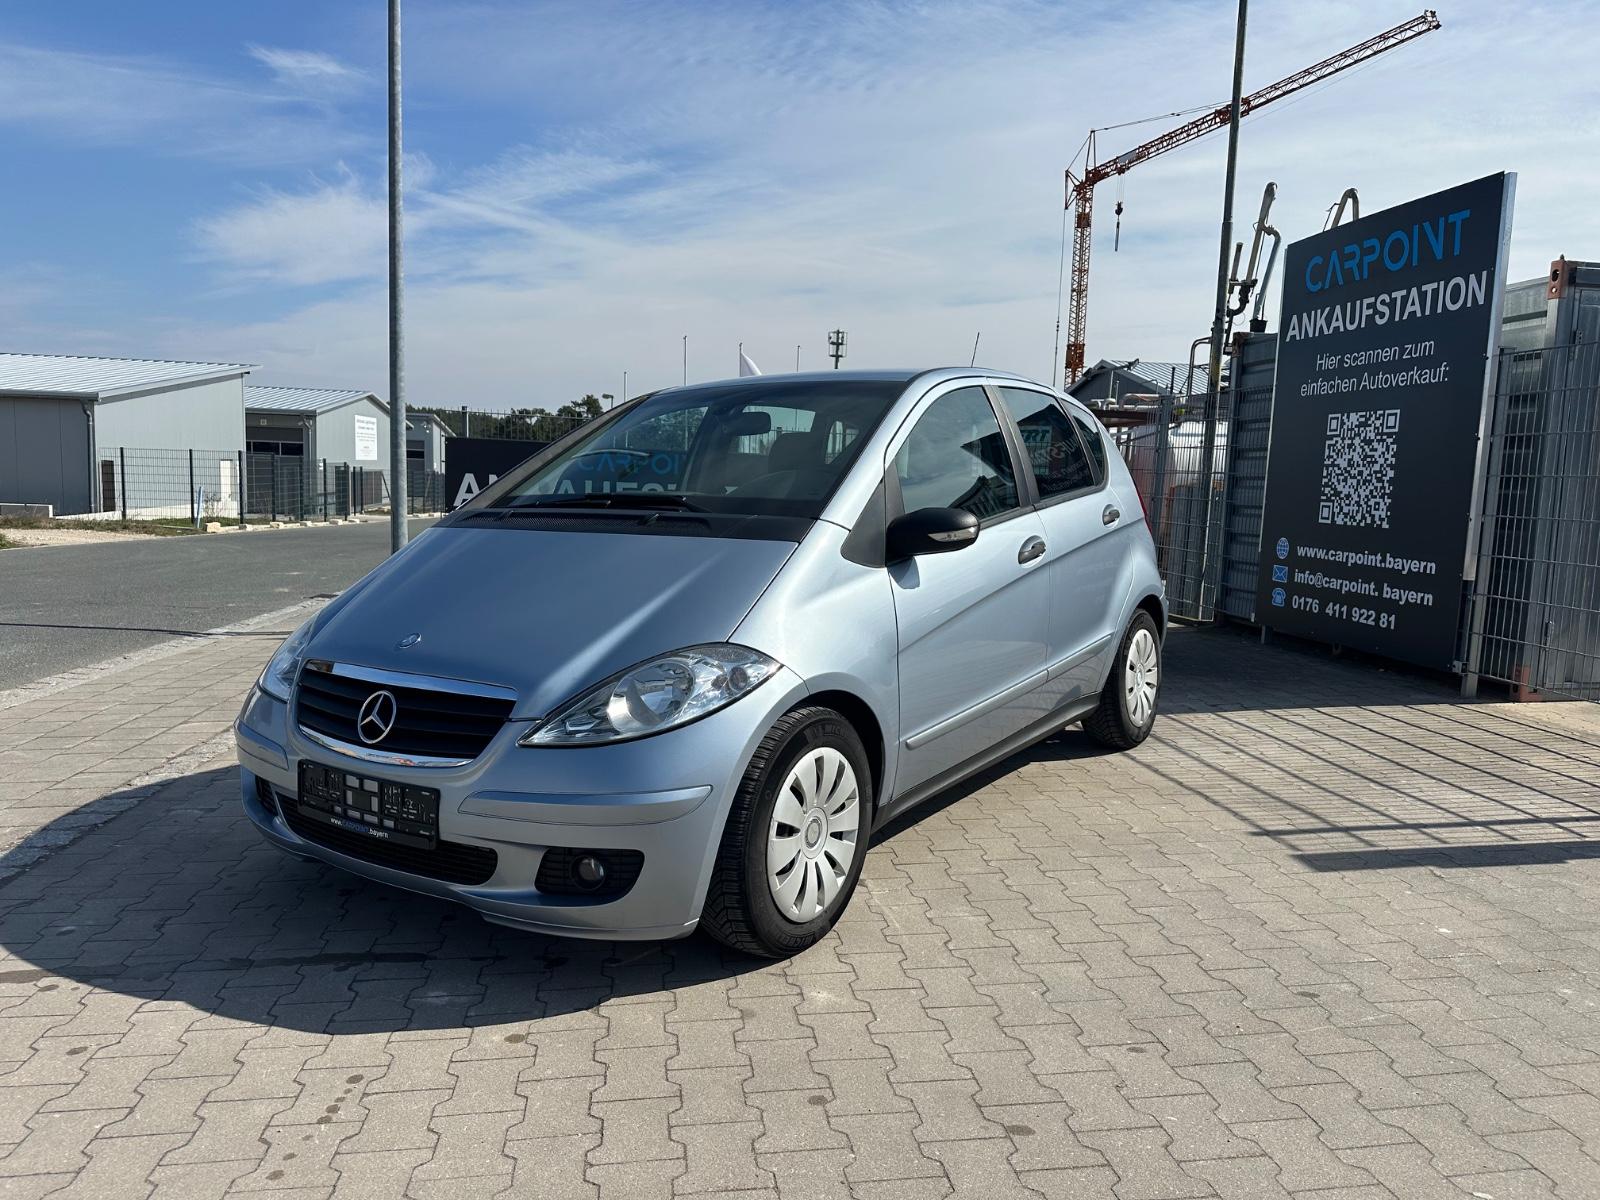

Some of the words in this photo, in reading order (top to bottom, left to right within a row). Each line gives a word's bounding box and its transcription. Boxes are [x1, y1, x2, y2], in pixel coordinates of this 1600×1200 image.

[1305, 209, 1471, 293] CARPOINT
[1285, 270, 1488, 342] ANKAUFSTATION
[1316, 353, 1341, 372] Hier
[1343, 345, 1399, 368] scannen
[1403, 340, 1435, 359] zum
[1300, 374, 1357, 397] einfachen
[1360, 362, 1449, 390] Autoverkauf:
[1297, 545, 1436, 575] www.carpoint.bayern
[1383, 583, 1433, 606] bayern
[1292, 595, 1319, 614] 0176
[1325, 602, 1348, 620] 411
[1351, 607, 1376, 626] 922
[1379, 613, 1396, 630] 81
